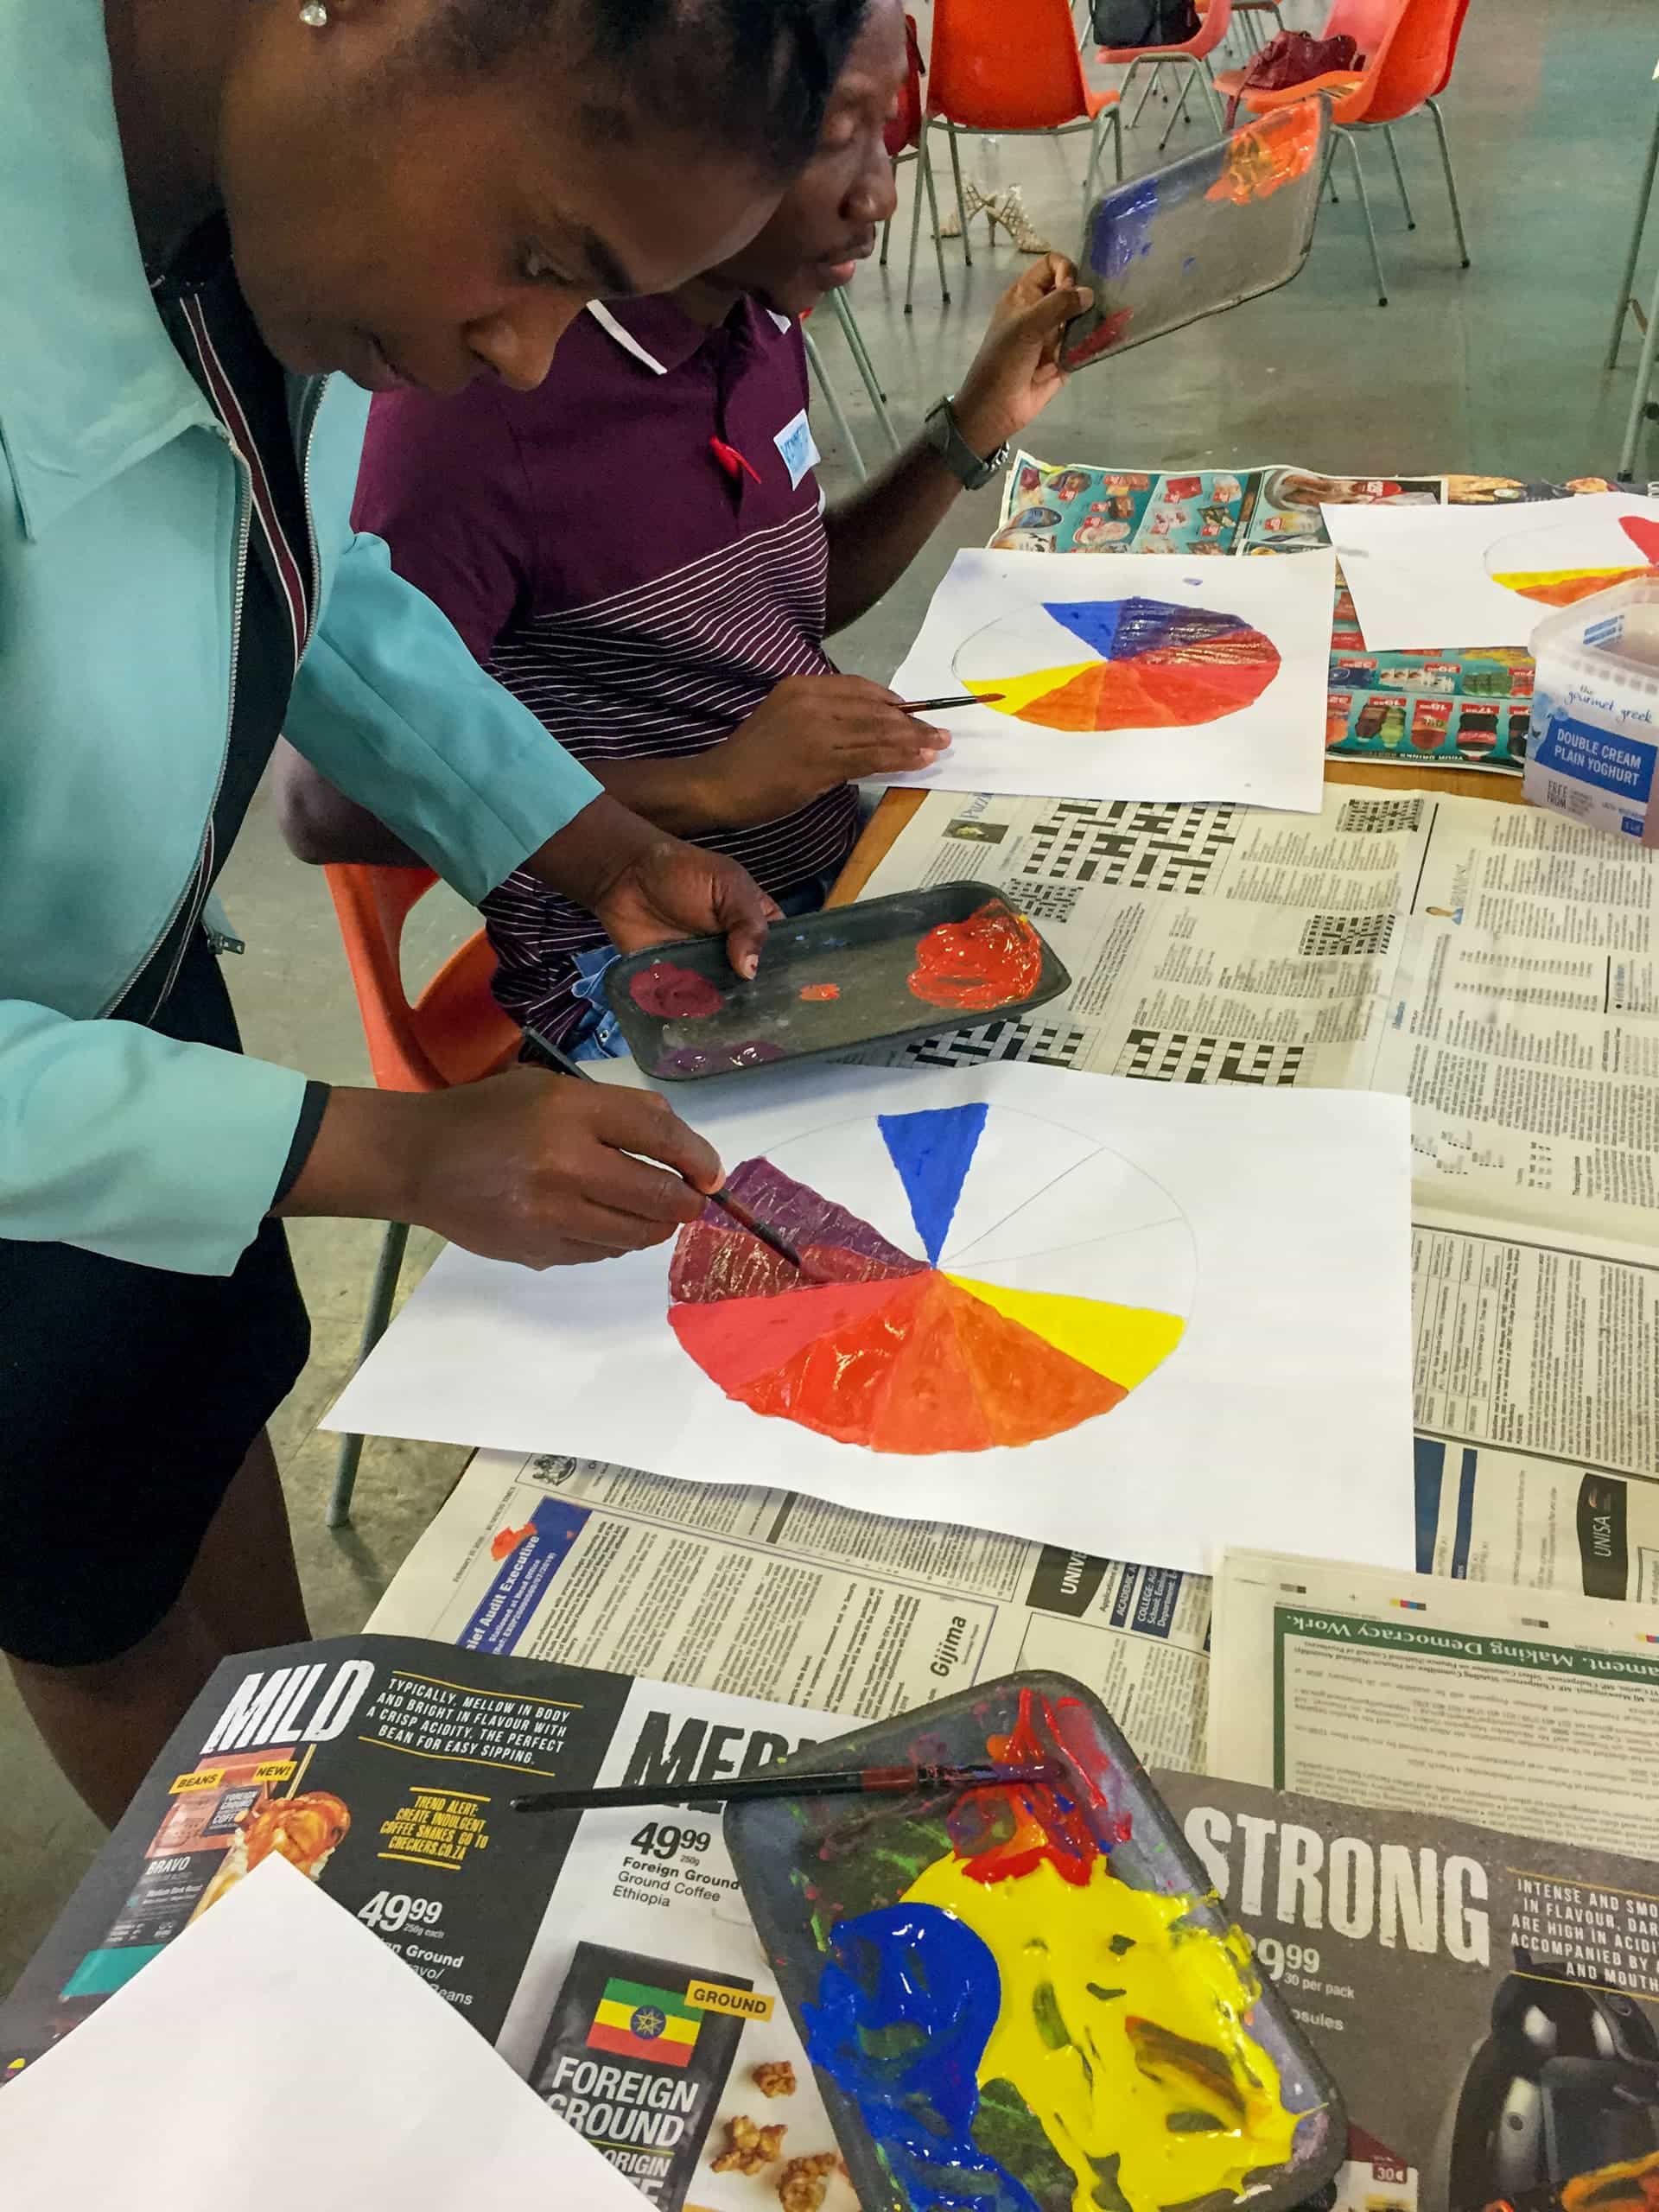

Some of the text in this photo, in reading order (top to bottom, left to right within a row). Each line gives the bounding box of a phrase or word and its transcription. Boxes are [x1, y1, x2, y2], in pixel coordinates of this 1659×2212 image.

[1565, 691, 1652, 725] gourmet greek
[1557, 728, 1641, 769] DOUBLE CREAM
[1555, 745, 1640, 786] PLAIN YOGHURT
[1548, 779, 1567, 795] FREE
[1548, 793, 1566, 809] FROM
[1594, 1515, 1611, 1557] UNISA
[480, 1592, 505, 1626] Audit
[500, 1533, 538, 1592] Executive
[1116, 1574, 1135, 1614] ACADEMIC
[1286, 1613, 1351, 1637] Work.
[1357, 1621, 1483, 1656] Democracy
[930, 1614, 967, 1679] Gijima
[1491, 1641, 1573, 1667] Making
[200, 1659, 375, 1755] MILD
[377, 1693, 567, 1737] AND BRIGHT IN FLAVOUR WITH
[462, 1696, 515, 1713] MELLOW
[518, 1704, 532, 1715] IN
[535, 1707, 570, 1723] BODY
[366, 1707, 376, 1718] A
[379, 1708, 418, 1726] CRISP
[480, 1729, 503, 1743] THE
[506, 1733, 564, 1753] PERFECT
[378, 1725, 535, 1765] BEAN FOR EASY SIPPING.
[178, 1774, 218, 1788] BEANS
[256, 1765, 291, 1777] NEW!
[414, 1796, 447, 1810] TREND
[379, 1821, 416, 1836] COFFEE
[458, 1832, 474, 1846] GO
[474, 1834, 489, 1849] TO
[396, 1808, 487, 1833] CREATE INDULGENT
[389, 1835, 467, 1860] CHECKERS.CO.ZA
[631, 1821, 711, 1859] 4999
[146, 1857, 191, 1875] BRAVO
[623, 1856, 741, 1891] Foreign Ground
[680, 1854, 700, 1866] 250g
[613, 1885, 671, 1907] Ethiopia
[618, 1871, 721, 1902] Ground Coffee
[1184, 1806, 1490, 1967] STRONG
[1517, 1878, 1581, 1904] INTENSE
[1589, 1892, 1619, 1910] AND
[358, 1891, 442, 1931] 4999
[1524, 1897, 1539, 1913] IN
[404, 1923, 424, 1936] 250g
[1512, 1914, 1659, 1955] ARE HIGH IN ACIDI
[406, 1944, 464, 1968] Ground
[1510, 1932, 1648, 1971] ACCOMPANIED BY
[408, 1964, 445, 1980] avo/
[1284, 1973, 1355, 1999] 30 per pack
[1567, 1961, 1659, 1992] AND MOUTH
[693, 1988, 766, 2014] GROUND
[551, 2056, 698, 2113] FOREIGN
[1377, 2167, 1394, 2181] 30
